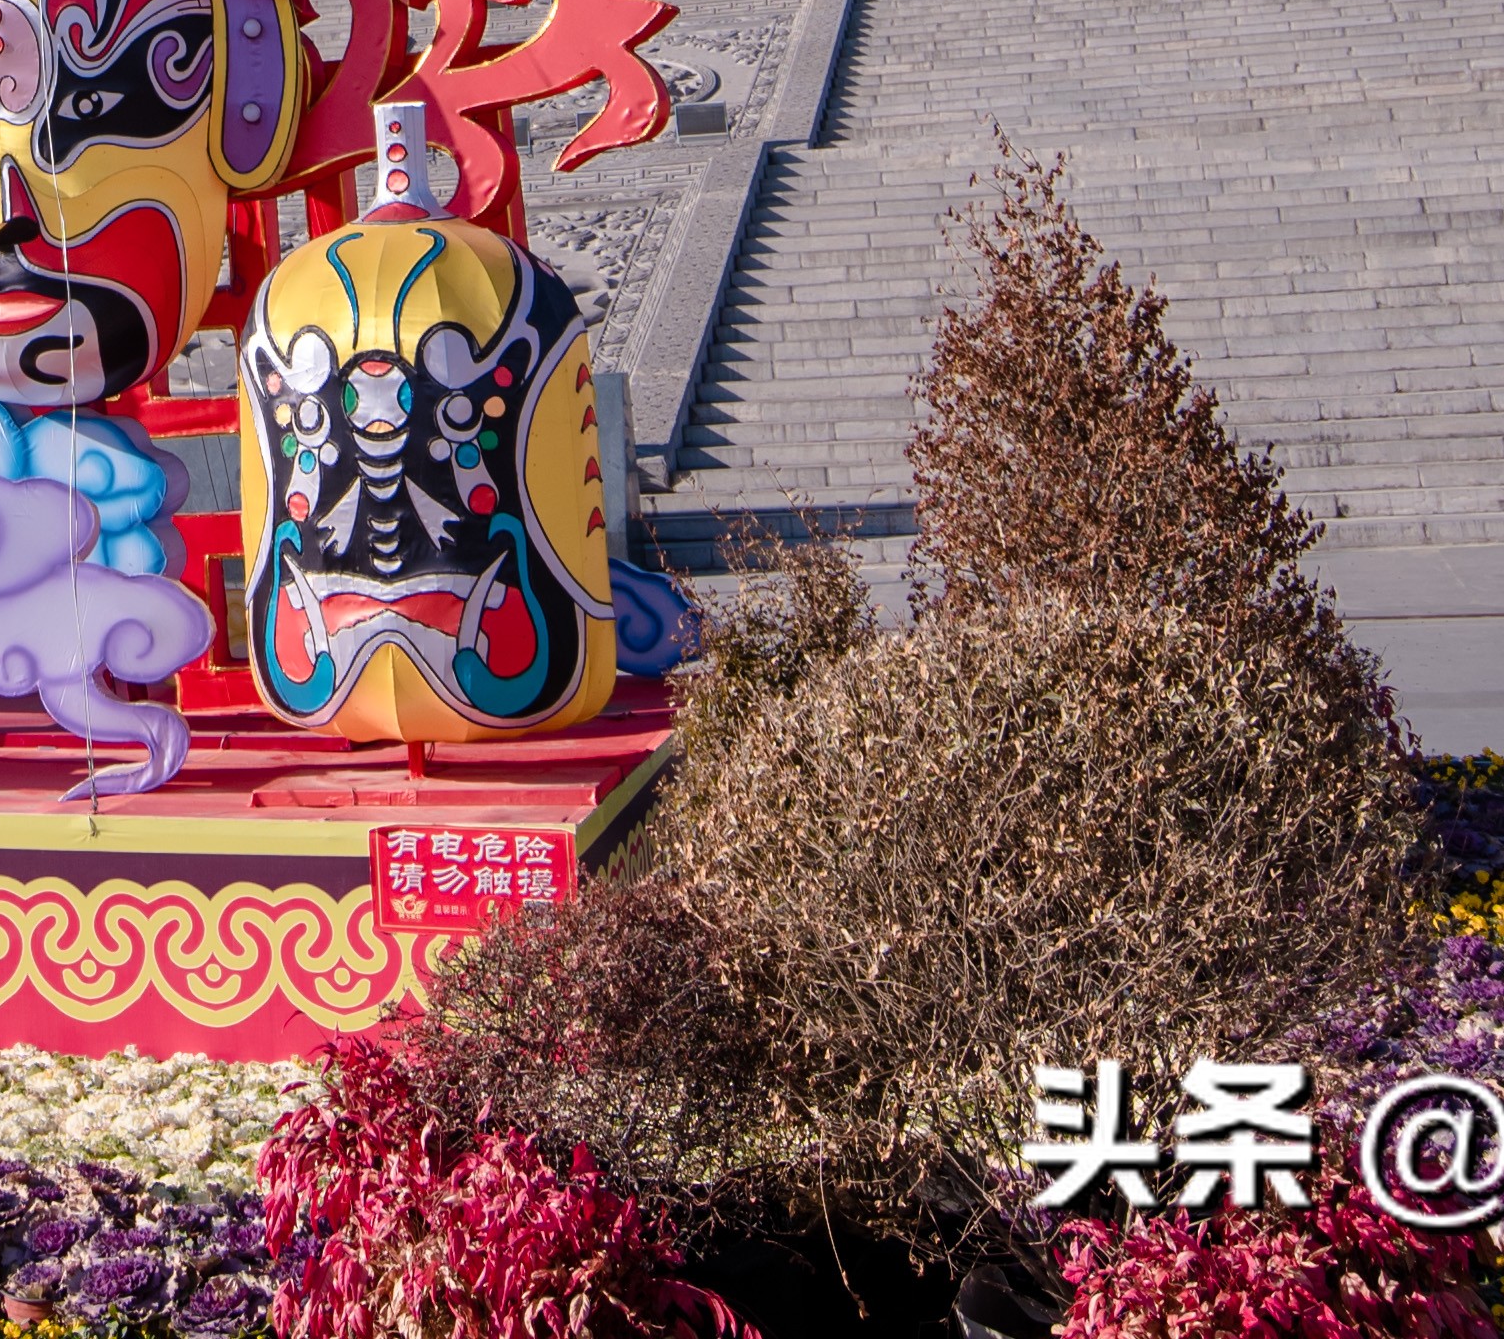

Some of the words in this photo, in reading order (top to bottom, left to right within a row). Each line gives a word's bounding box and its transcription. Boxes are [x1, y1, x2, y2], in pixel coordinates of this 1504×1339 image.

[387, 829, 555, 864] 有电危险
[388, 862, 558, 898] 请勿触摸
